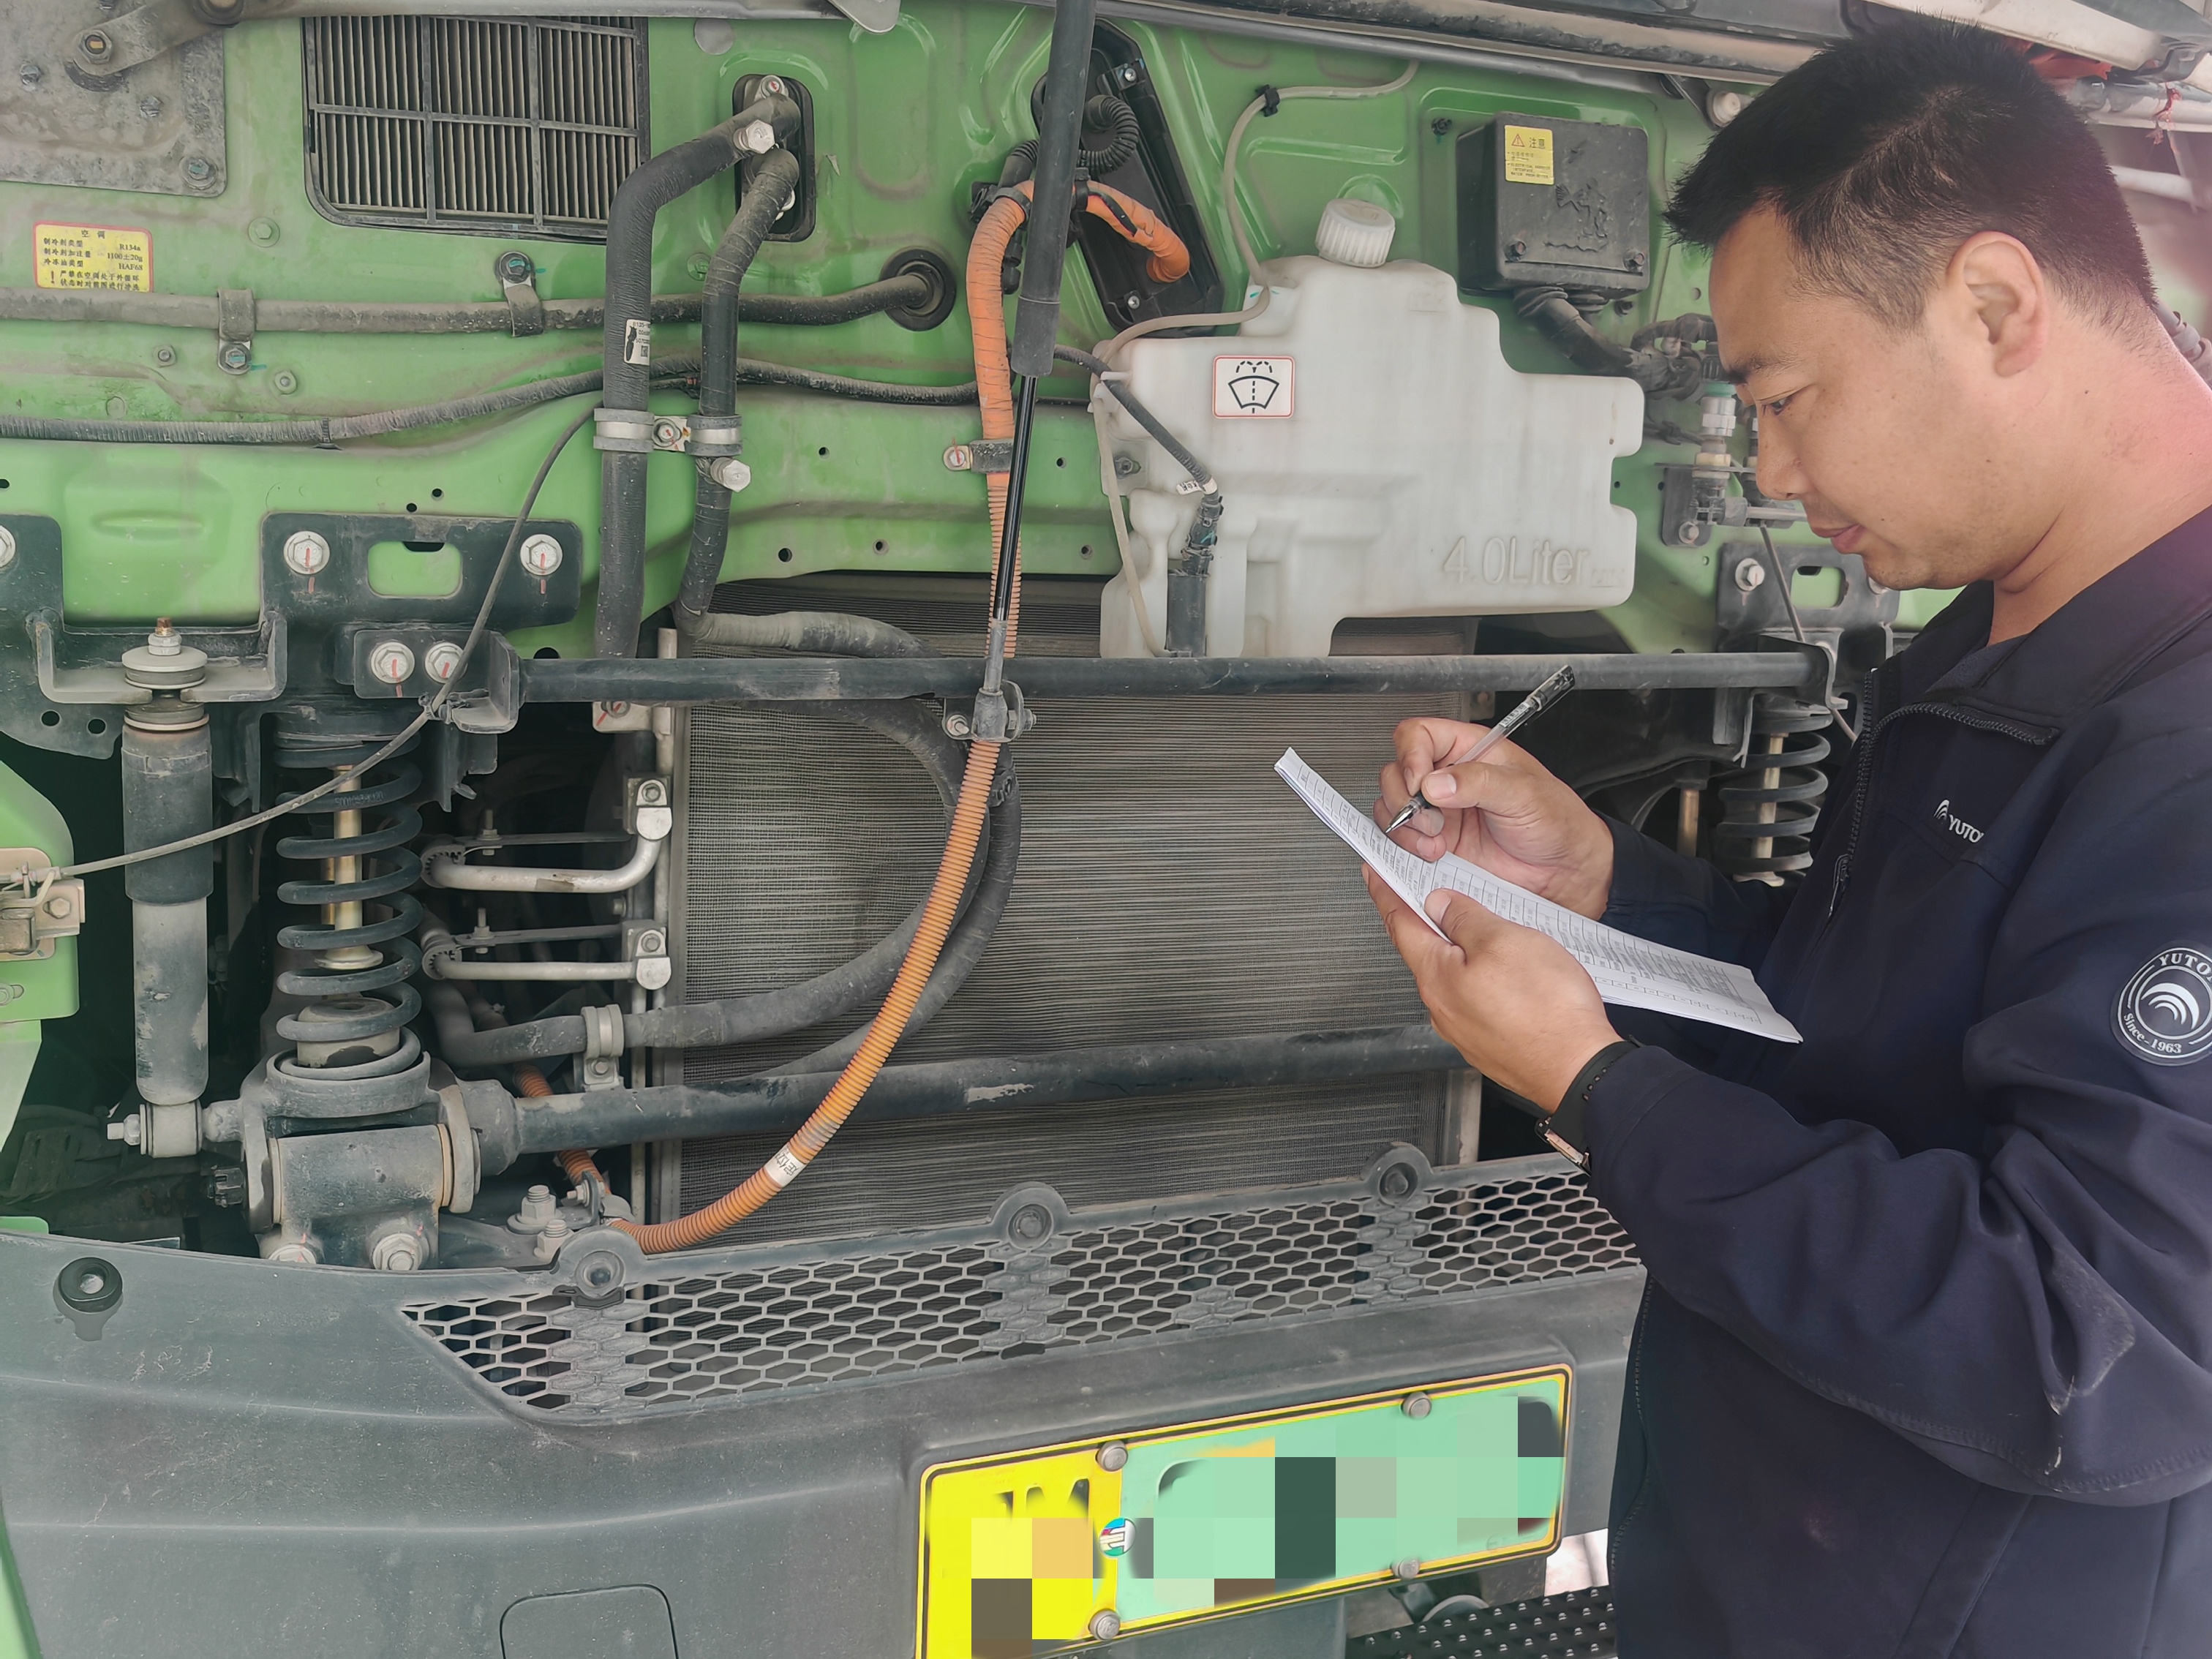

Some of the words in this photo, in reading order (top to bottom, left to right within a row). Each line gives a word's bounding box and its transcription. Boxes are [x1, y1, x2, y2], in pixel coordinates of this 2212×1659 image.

[1529, 137, 1546, 149] 注意
[81, 229, 105, 240] 空调
[119, 244, 141, 252] R134a
[1949, 814, 1985, 843] YUTO
